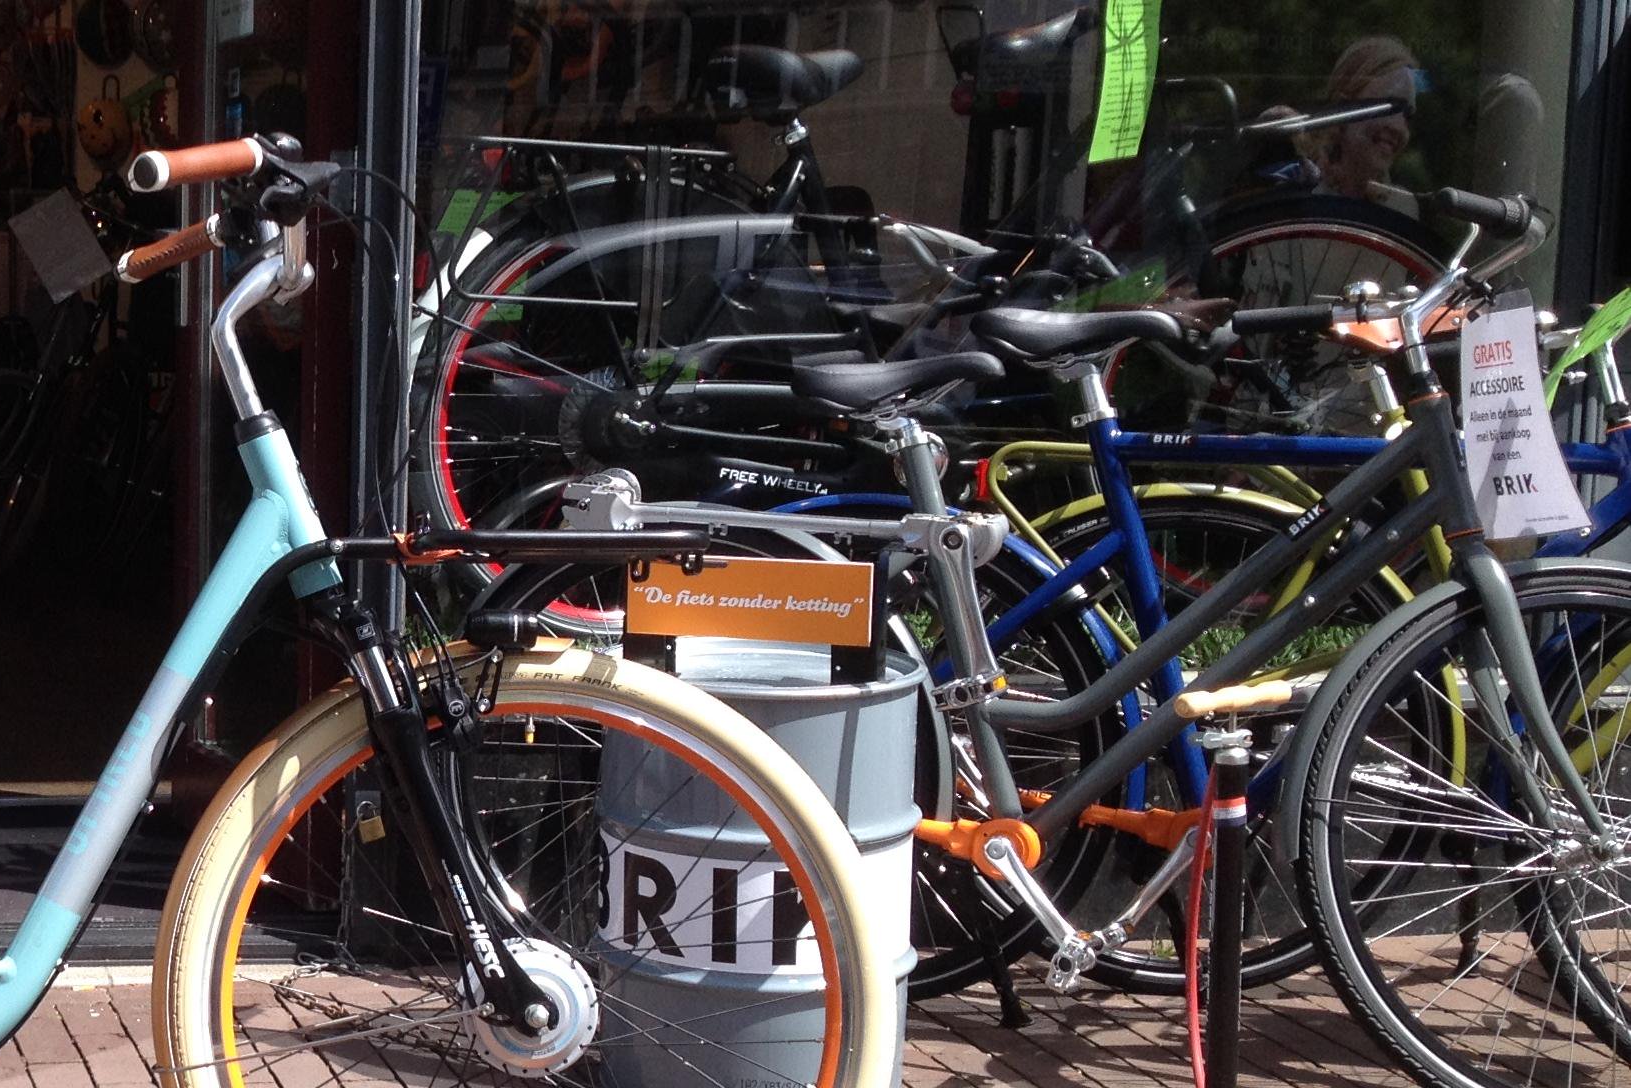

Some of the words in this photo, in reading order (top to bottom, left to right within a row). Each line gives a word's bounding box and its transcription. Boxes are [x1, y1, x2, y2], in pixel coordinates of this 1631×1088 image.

[1473, 340, 1513, 365] GRATIS
[1470, 375, 1526, 398] ACCESSOIRE
[1470, 410, 1489, 423] Alleen
[1497, 408, 1507, 419] de
[1152, 434, 1193, 445] BRIK
[1492, 451, 1506, 461] van
[1507, 450, 1521, 460] een
[719, 467, 759, 484] FREE
[1492, 473, 1538, 496] BRIK
[1288, 504, 1325, 537] BRIK
[675, 590, 714, 607] fiets
[718, 593, 782, 611] zonder
[533, 672, 564, 681] FAT
